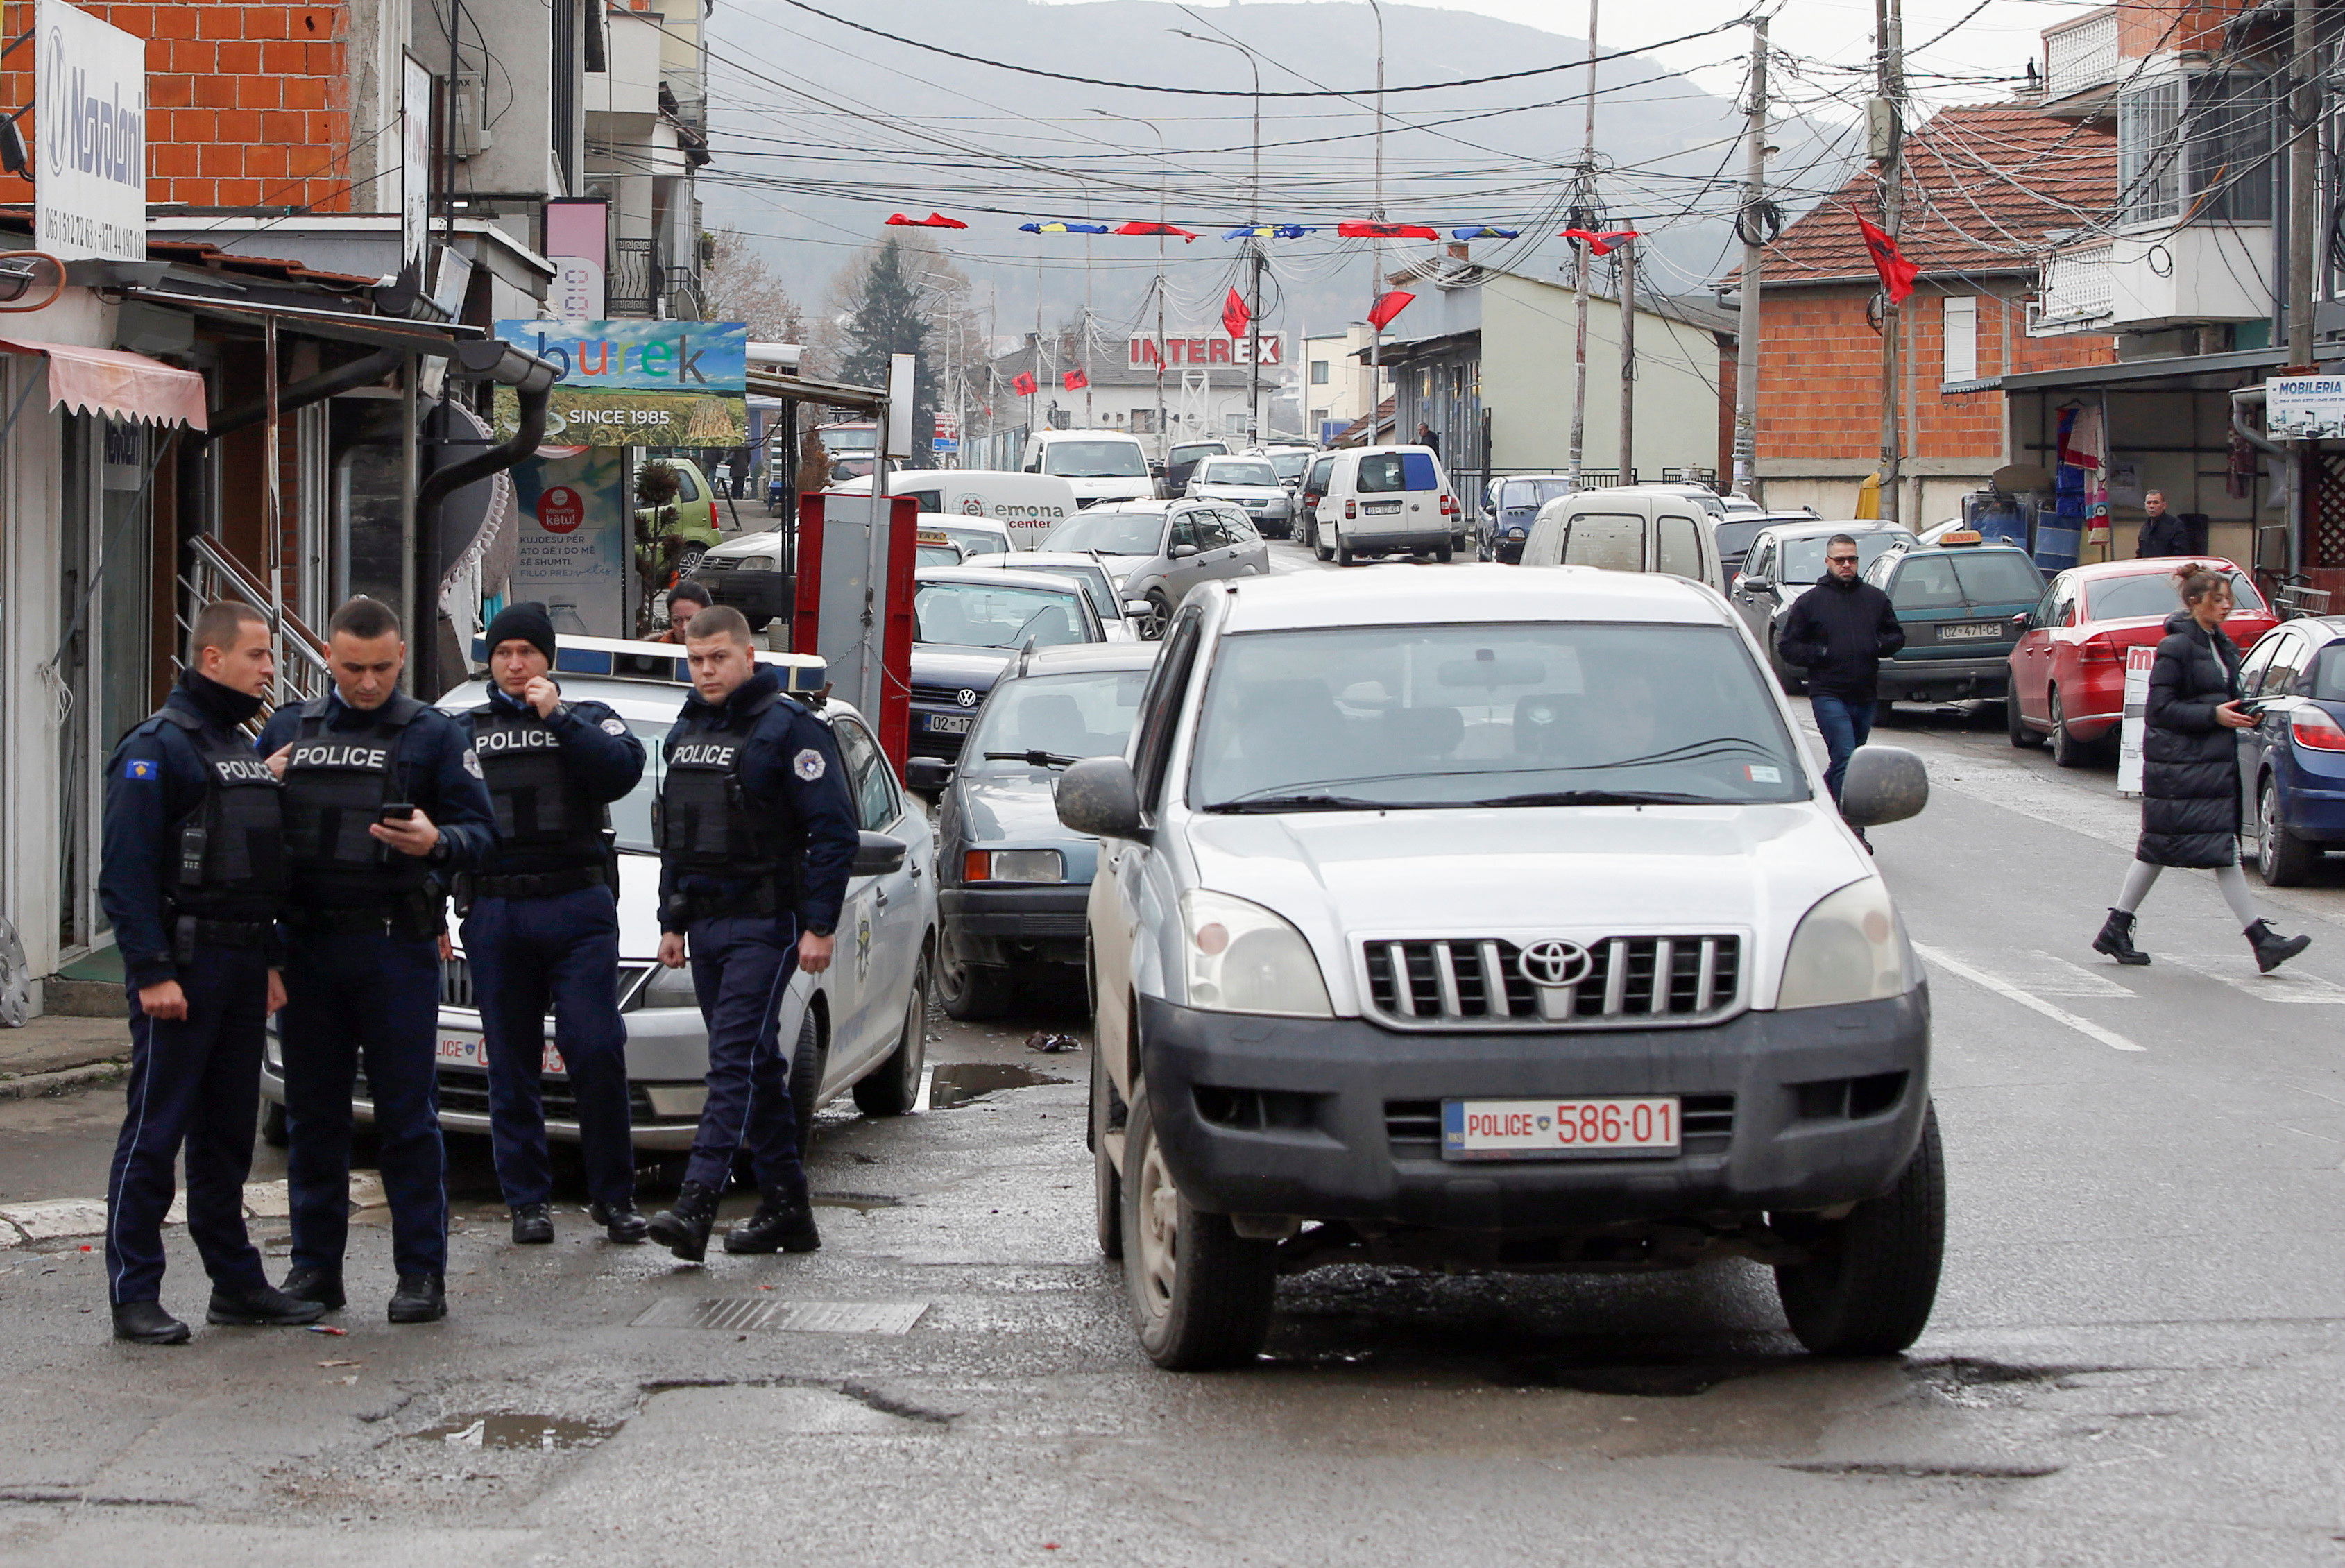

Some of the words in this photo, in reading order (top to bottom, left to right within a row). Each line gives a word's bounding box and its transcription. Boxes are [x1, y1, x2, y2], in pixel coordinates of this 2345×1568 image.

[46, 207, 58, 241] 065
[63, 212, 74, 244] 512
[76, 215, 83, 246] 72
[85, 218, 93, 250] 63
[114, 225, 121, 255] 44
[123, 228, 133, 258] 197
[538, 331, 706, 384] burek
[2280, 381, 2342, 395] MOBILERIA
[569, 409, 625, 425] SINCE
[630, 409, 670, 425] 1985
[994, 504, 1065, 518] emona
[546, 513, 576, 525] këtu!
[1009, 520, 1052, 529] center
[520, 536, 563, 544] KUJDESU
[566, 535, 585, 544] PËR
[520, 547, 539, 555] ATO
[542, 545, 556, 555] QË
[564, 547, 579, 555] DO
[581, 545, 595, 555] MË
[520, 557, 531, 566] SË
[534, 558, 572, 566] SHUMTI.
[550, 569, 573, 577] PREJ
[1945, 625, 1958, 638] 02
[932, 715, 948, 731] 02
[475, 730, 560, 754] POLICE
[292, 746, 386, 768] POLICE
[670, 744, 735, 766] POLICE
[1468, 1114, 1533, 1136] POLICE
